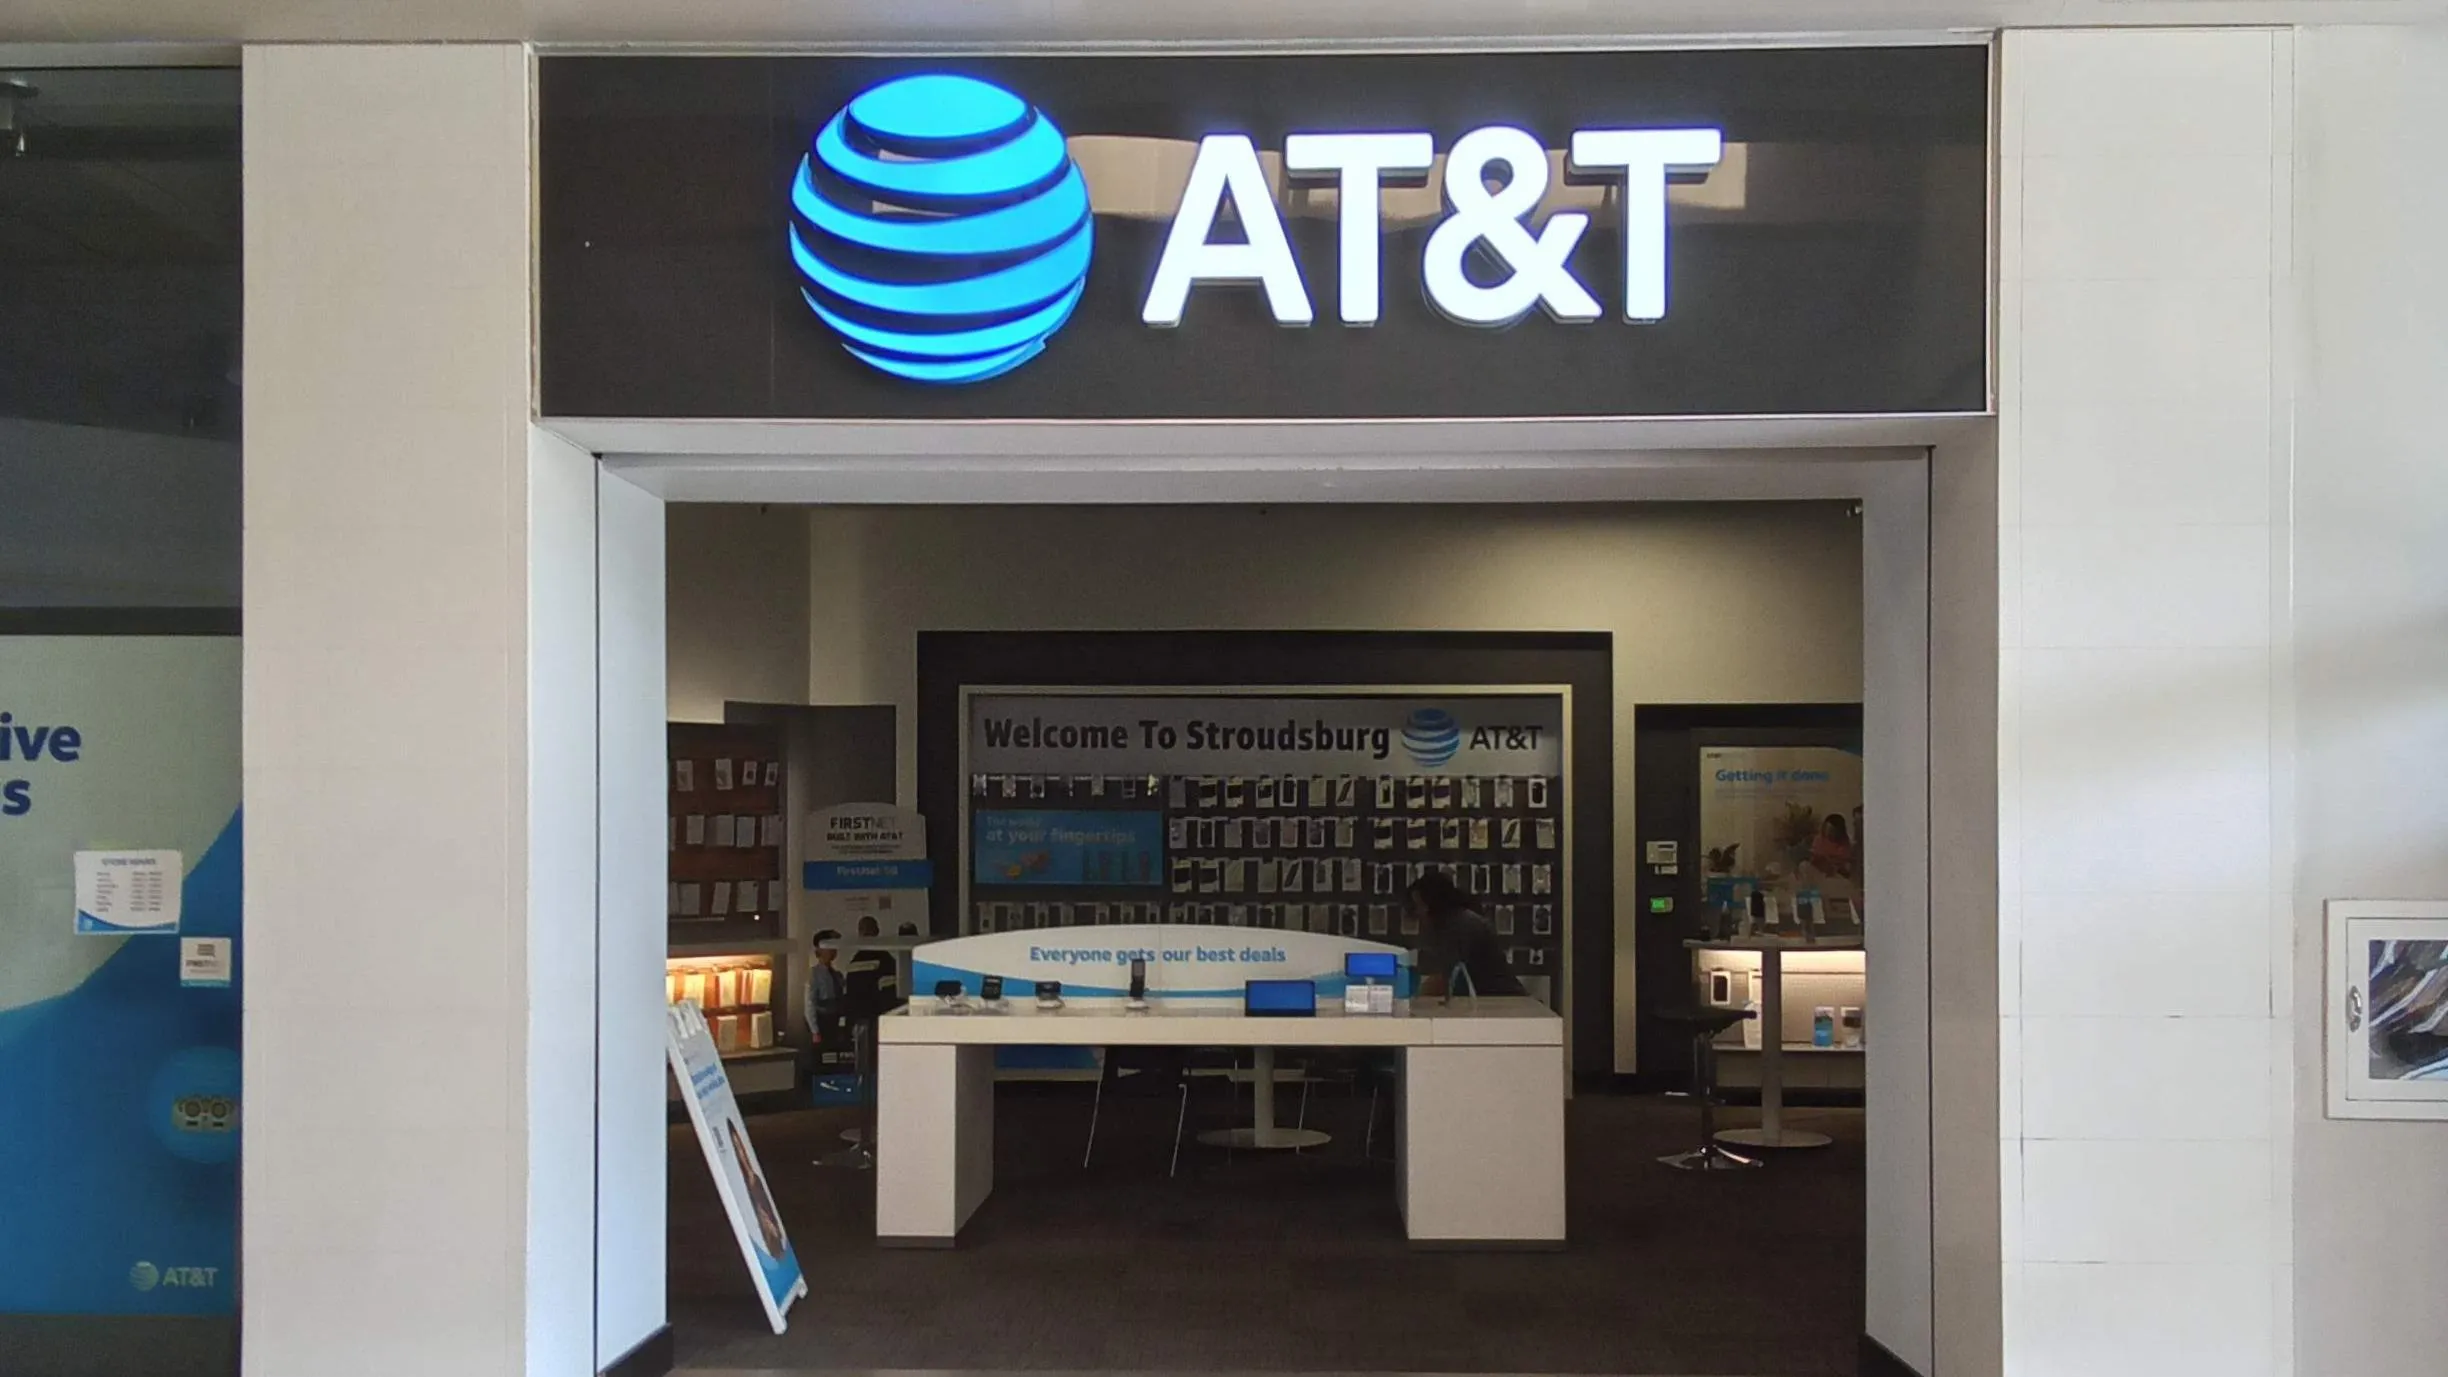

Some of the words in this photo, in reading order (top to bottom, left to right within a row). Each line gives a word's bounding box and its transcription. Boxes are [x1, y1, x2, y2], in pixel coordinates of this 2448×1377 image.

[1142, 126, 1722, 325] AT&T
[984, 718, 1128, 749] Welcome
[1138, 720, 1177, 749] To
[1186, 719, 1391, 761] Stroudsburg
[1469, 725, 1543, 750] AT&T
[1715, 769, 1774, 785] Getting
[985, 829, 1004, 842] at
[1008, 830, 1047, 845] your
[1050, 827, 1137, 846] fingertips
[1030, 946, 1112, 966] Everyone
[1116, 947, 1155, 966] gets
[1162, 950, 1193, 963] our
[1196, 946, 1235, 963] best
[1239, 946, 1287, 963] deals
[162, 1266, 219, 1288] AT&T
